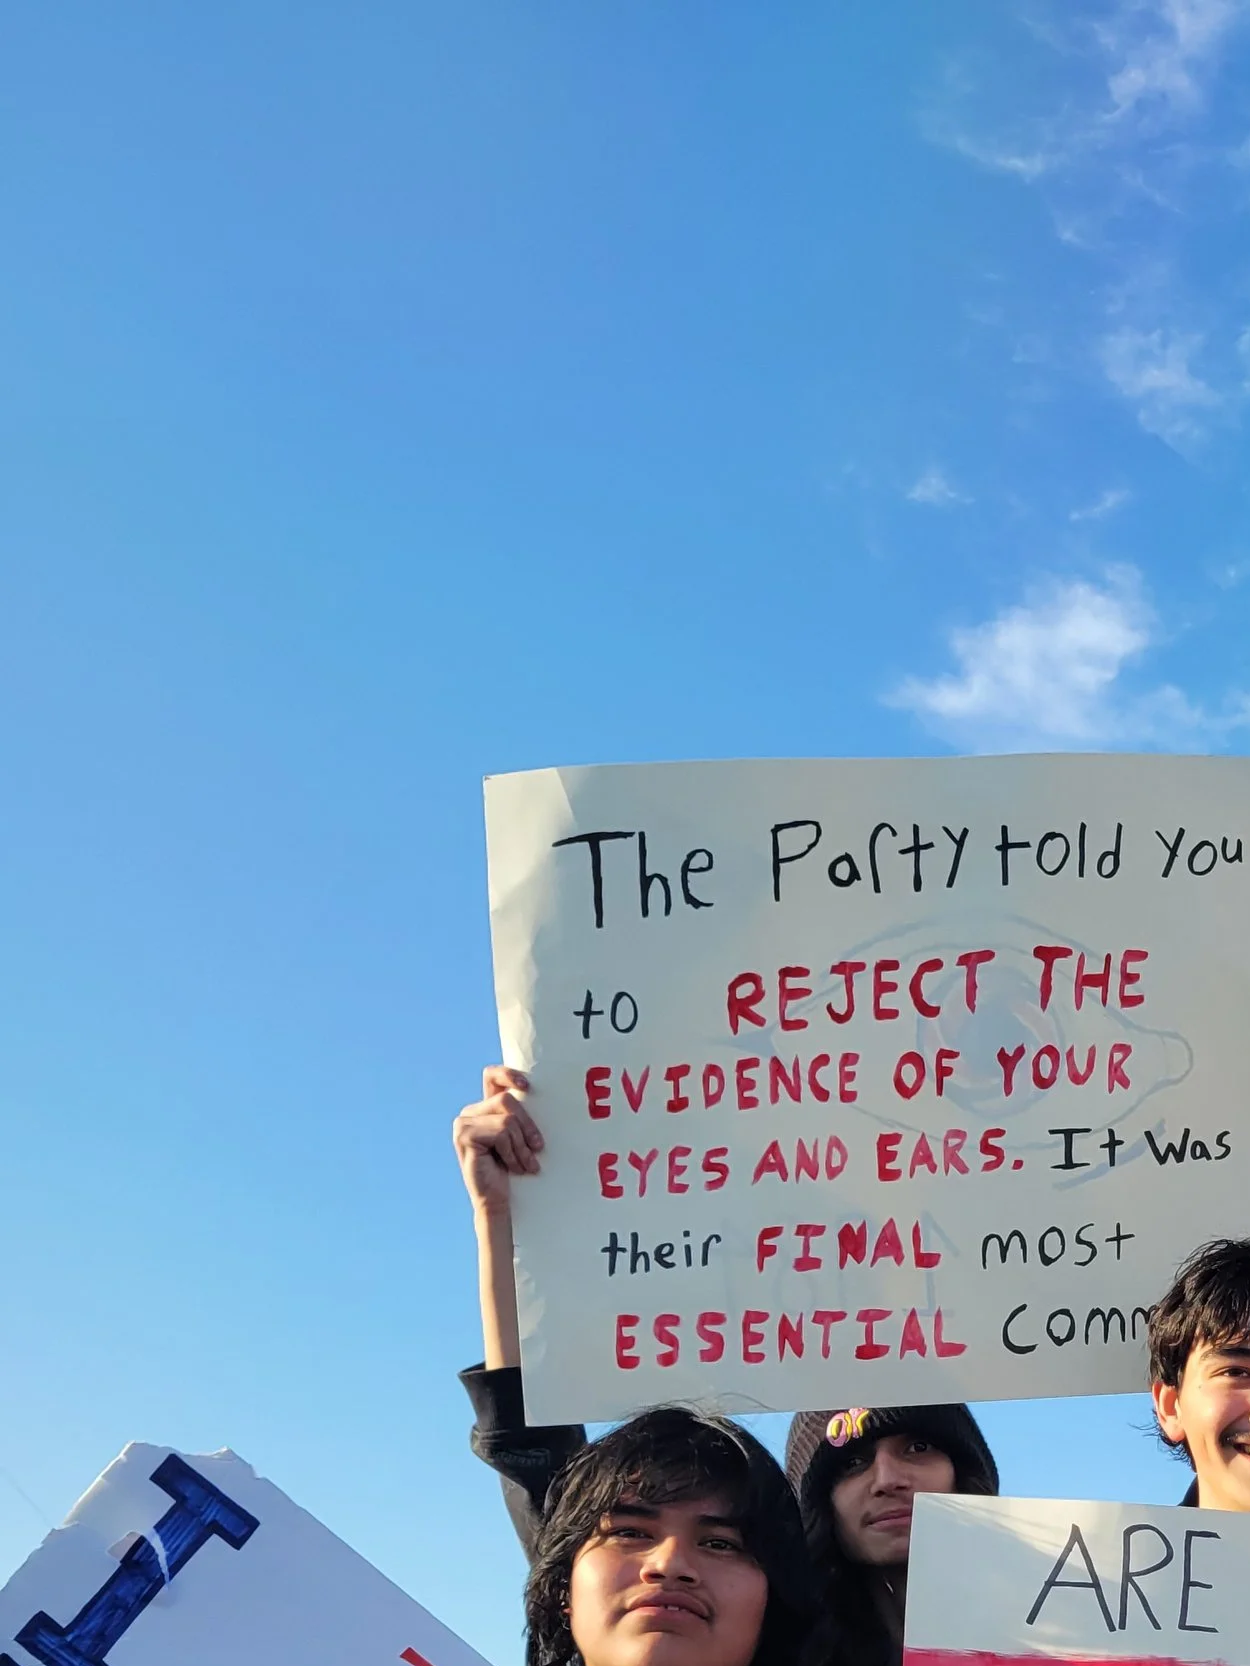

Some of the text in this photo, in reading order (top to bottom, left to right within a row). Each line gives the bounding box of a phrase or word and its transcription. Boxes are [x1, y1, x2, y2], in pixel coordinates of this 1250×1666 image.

[552, 830, 714, 929] The
[995, 822, 1123, 886] told
[727, 949, 996, 1035] REJECT
[1033, 945, 1149, 1013] THE
[584, 1043, 1132, 1120] EVIDENCE OF YOUR
[598, 1145, 731, 1199] EYES
[751, 1134, 849, 1186] AND
[876, 1128, 1024, 1182] EARS.
[1048, 1127, 1124, 1170] It
[600, 1230, 722, 1277] their
[756, 1217, 942, 1273] FINAL
[981, 1221, 1135, 1270] most
[615, 1306, 968, 1370] ESSENTIAL
[1025, 1523, 1222, 1633] ARE
